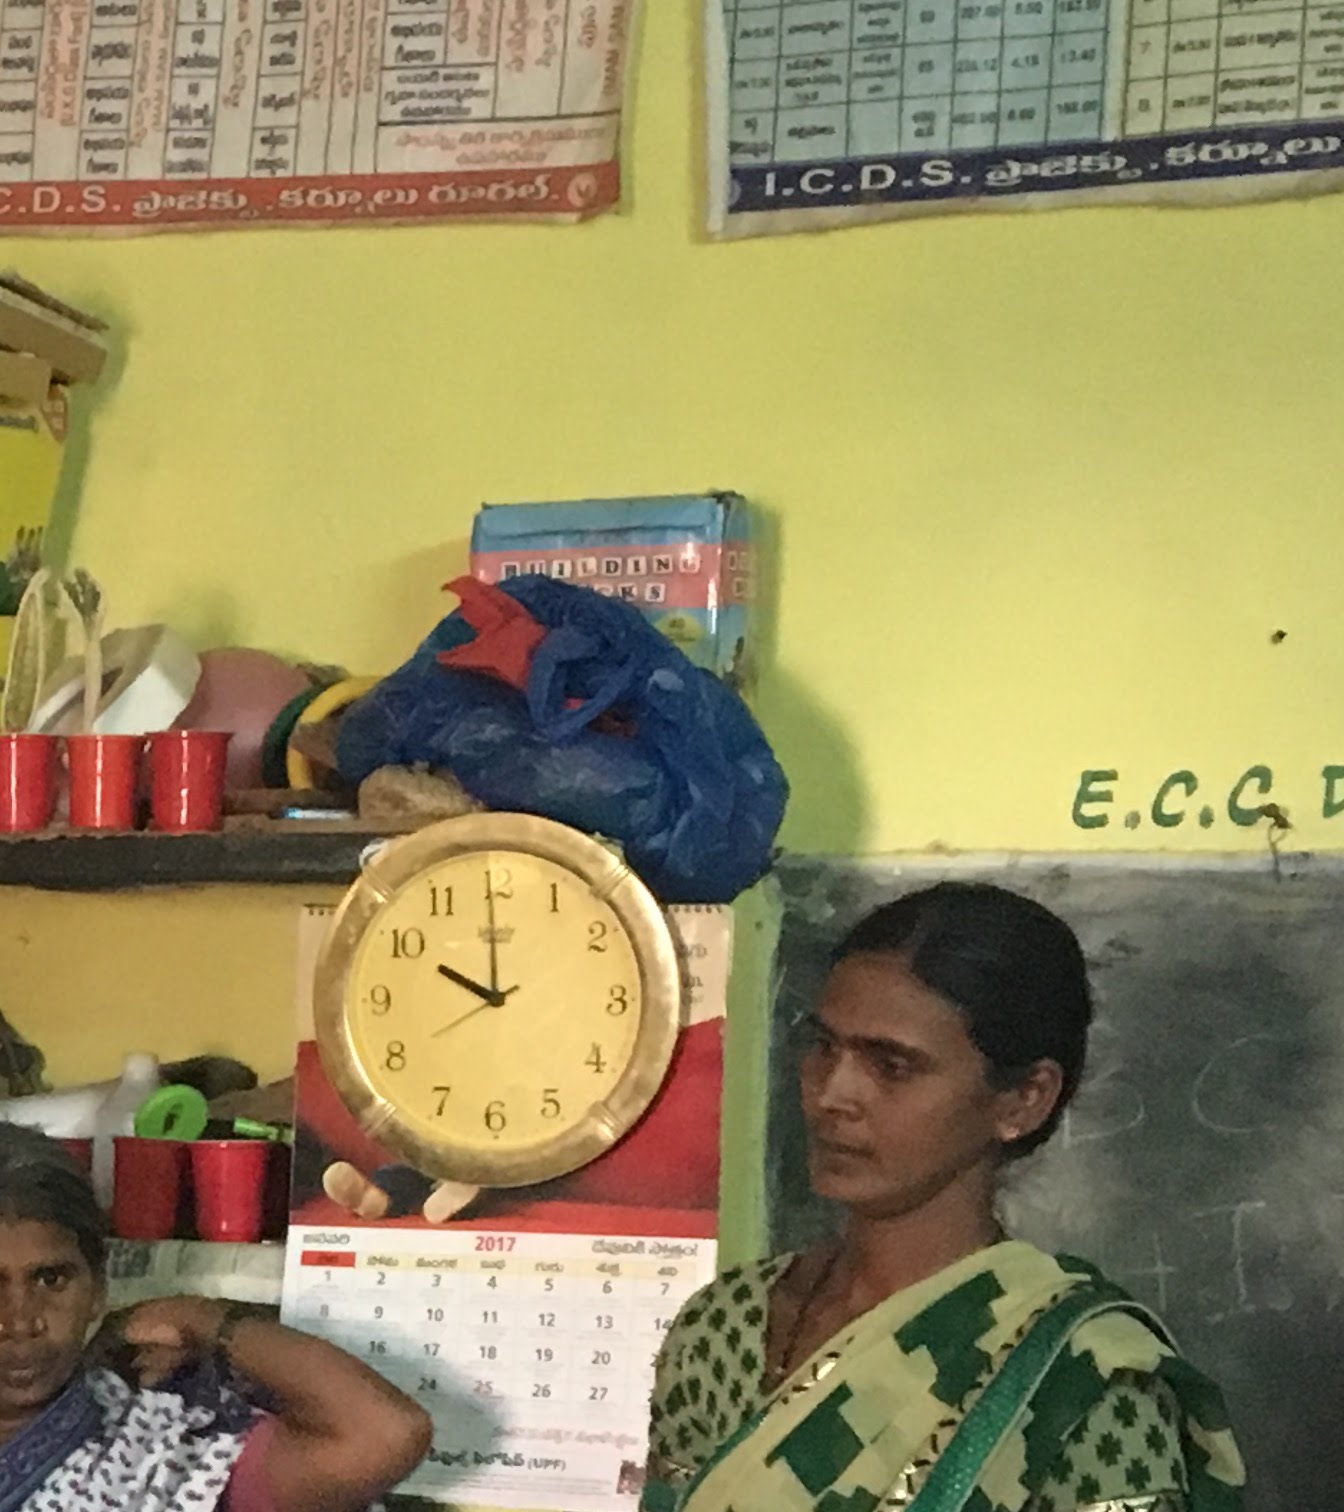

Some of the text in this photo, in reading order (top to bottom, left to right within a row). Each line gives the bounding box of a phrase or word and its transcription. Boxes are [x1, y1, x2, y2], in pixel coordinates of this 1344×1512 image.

[765, 160, 972, 196] I.C.D.S.
[429, 885, 455, 916] 11
[484, 868, 513, 901] 12
[549, 882, 560, 913] 1
[390, 927, 426, 959] 10
[587, 920, 608, 953] 2
[370, 984, 392, 1016] 9
[605, 984, 628, 1016] 3
[385, 1040, 407, 1072] 8
[583, 1042, 608, 1074] 4
[431, 1085, 452, 1117] 7
[484, 1099, 507, 1132] 6
[540, 1087, 562, 1119] 5
[474, 1235, 517, 1252] 2017
[377, 1272, 387, 1286] 2
[431, 1274, 442, 1288] 3
[487, 1275, 498, 1290] 4
[544, 1278, 555, 1292] 5
[601, 1280, 613, 1295] 6
[660, 1282, 671, 1296] 7
[374, 1306, 384, 1320] 9
[426, 1308, 444, 1322] 10
[482, 1311, 499, 1325] 11
[538, 1312, 556, 1328] 12
[595, 1315, 614, 1330] 13
[369, 1340, 612, 1366] 16 17 18 19 20
[417, 1377, 437, 1392] 24
[532, 1383, 552, 1399] 26
[588, 1386, 609, 1402] 27
